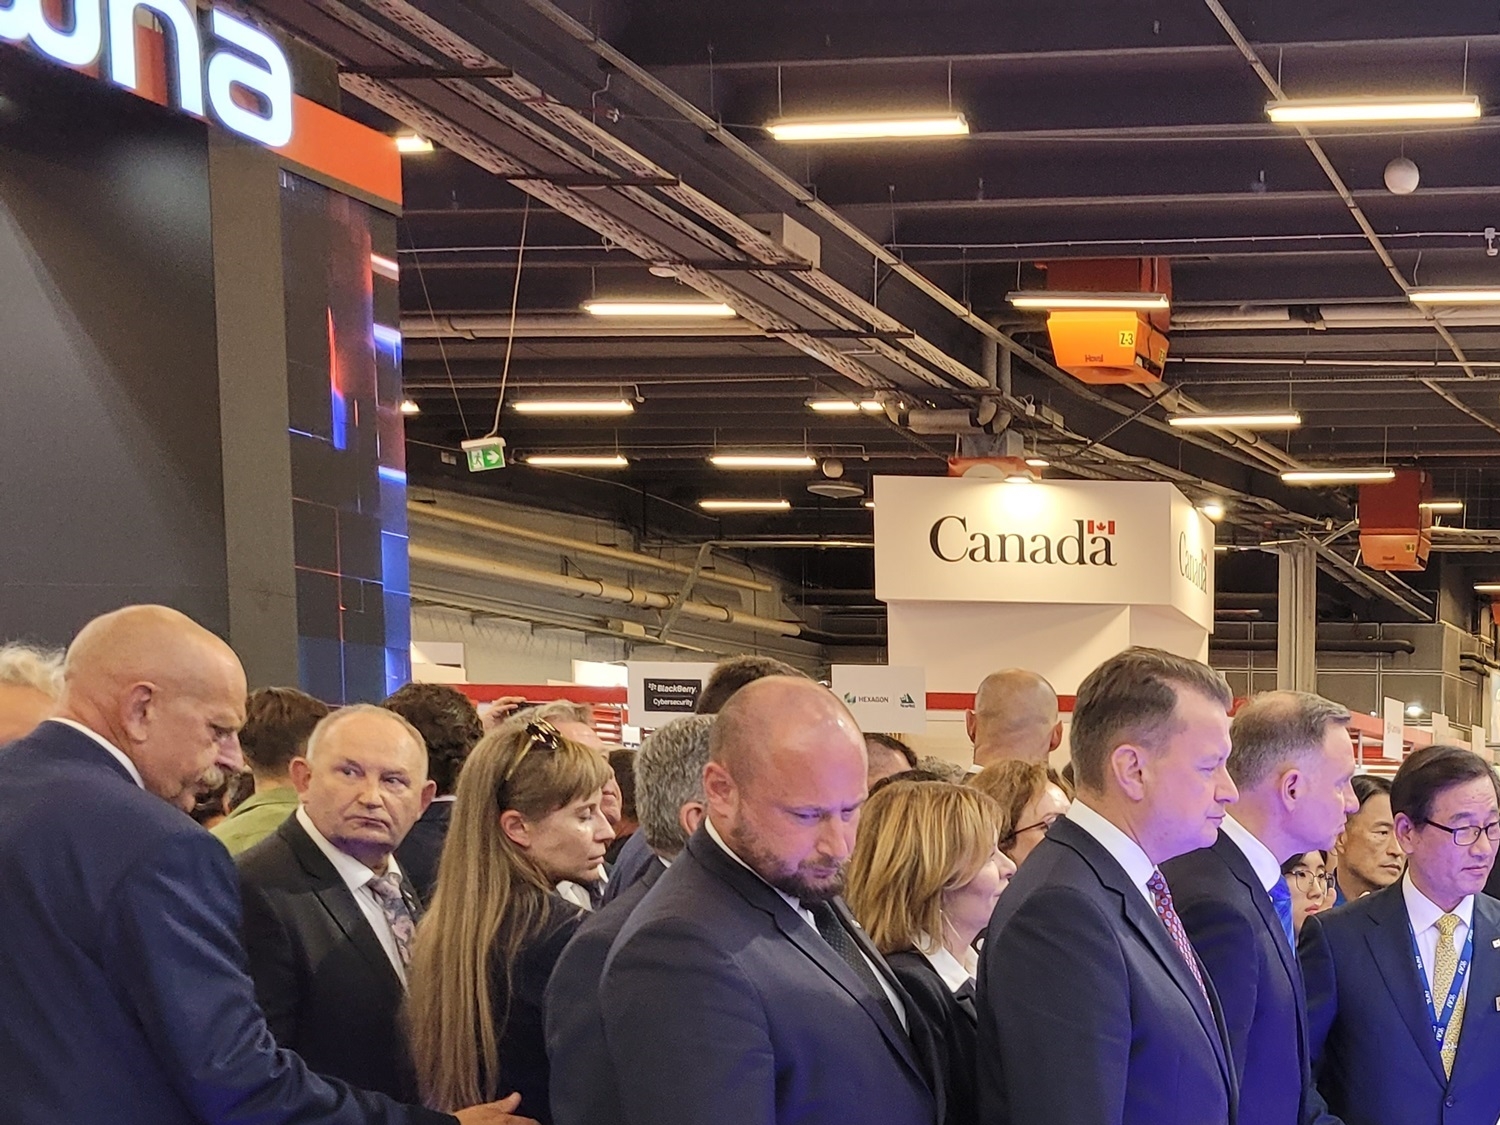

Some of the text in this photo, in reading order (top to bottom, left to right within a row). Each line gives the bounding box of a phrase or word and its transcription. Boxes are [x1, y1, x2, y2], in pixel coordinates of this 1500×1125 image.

[1120, 333, 1134, 345] Z-3
[929, 515, 1117, 567] Canada
[1178, 531, 1208, 595] Canada
[652, 697, 694, 707] Cybersecurity
